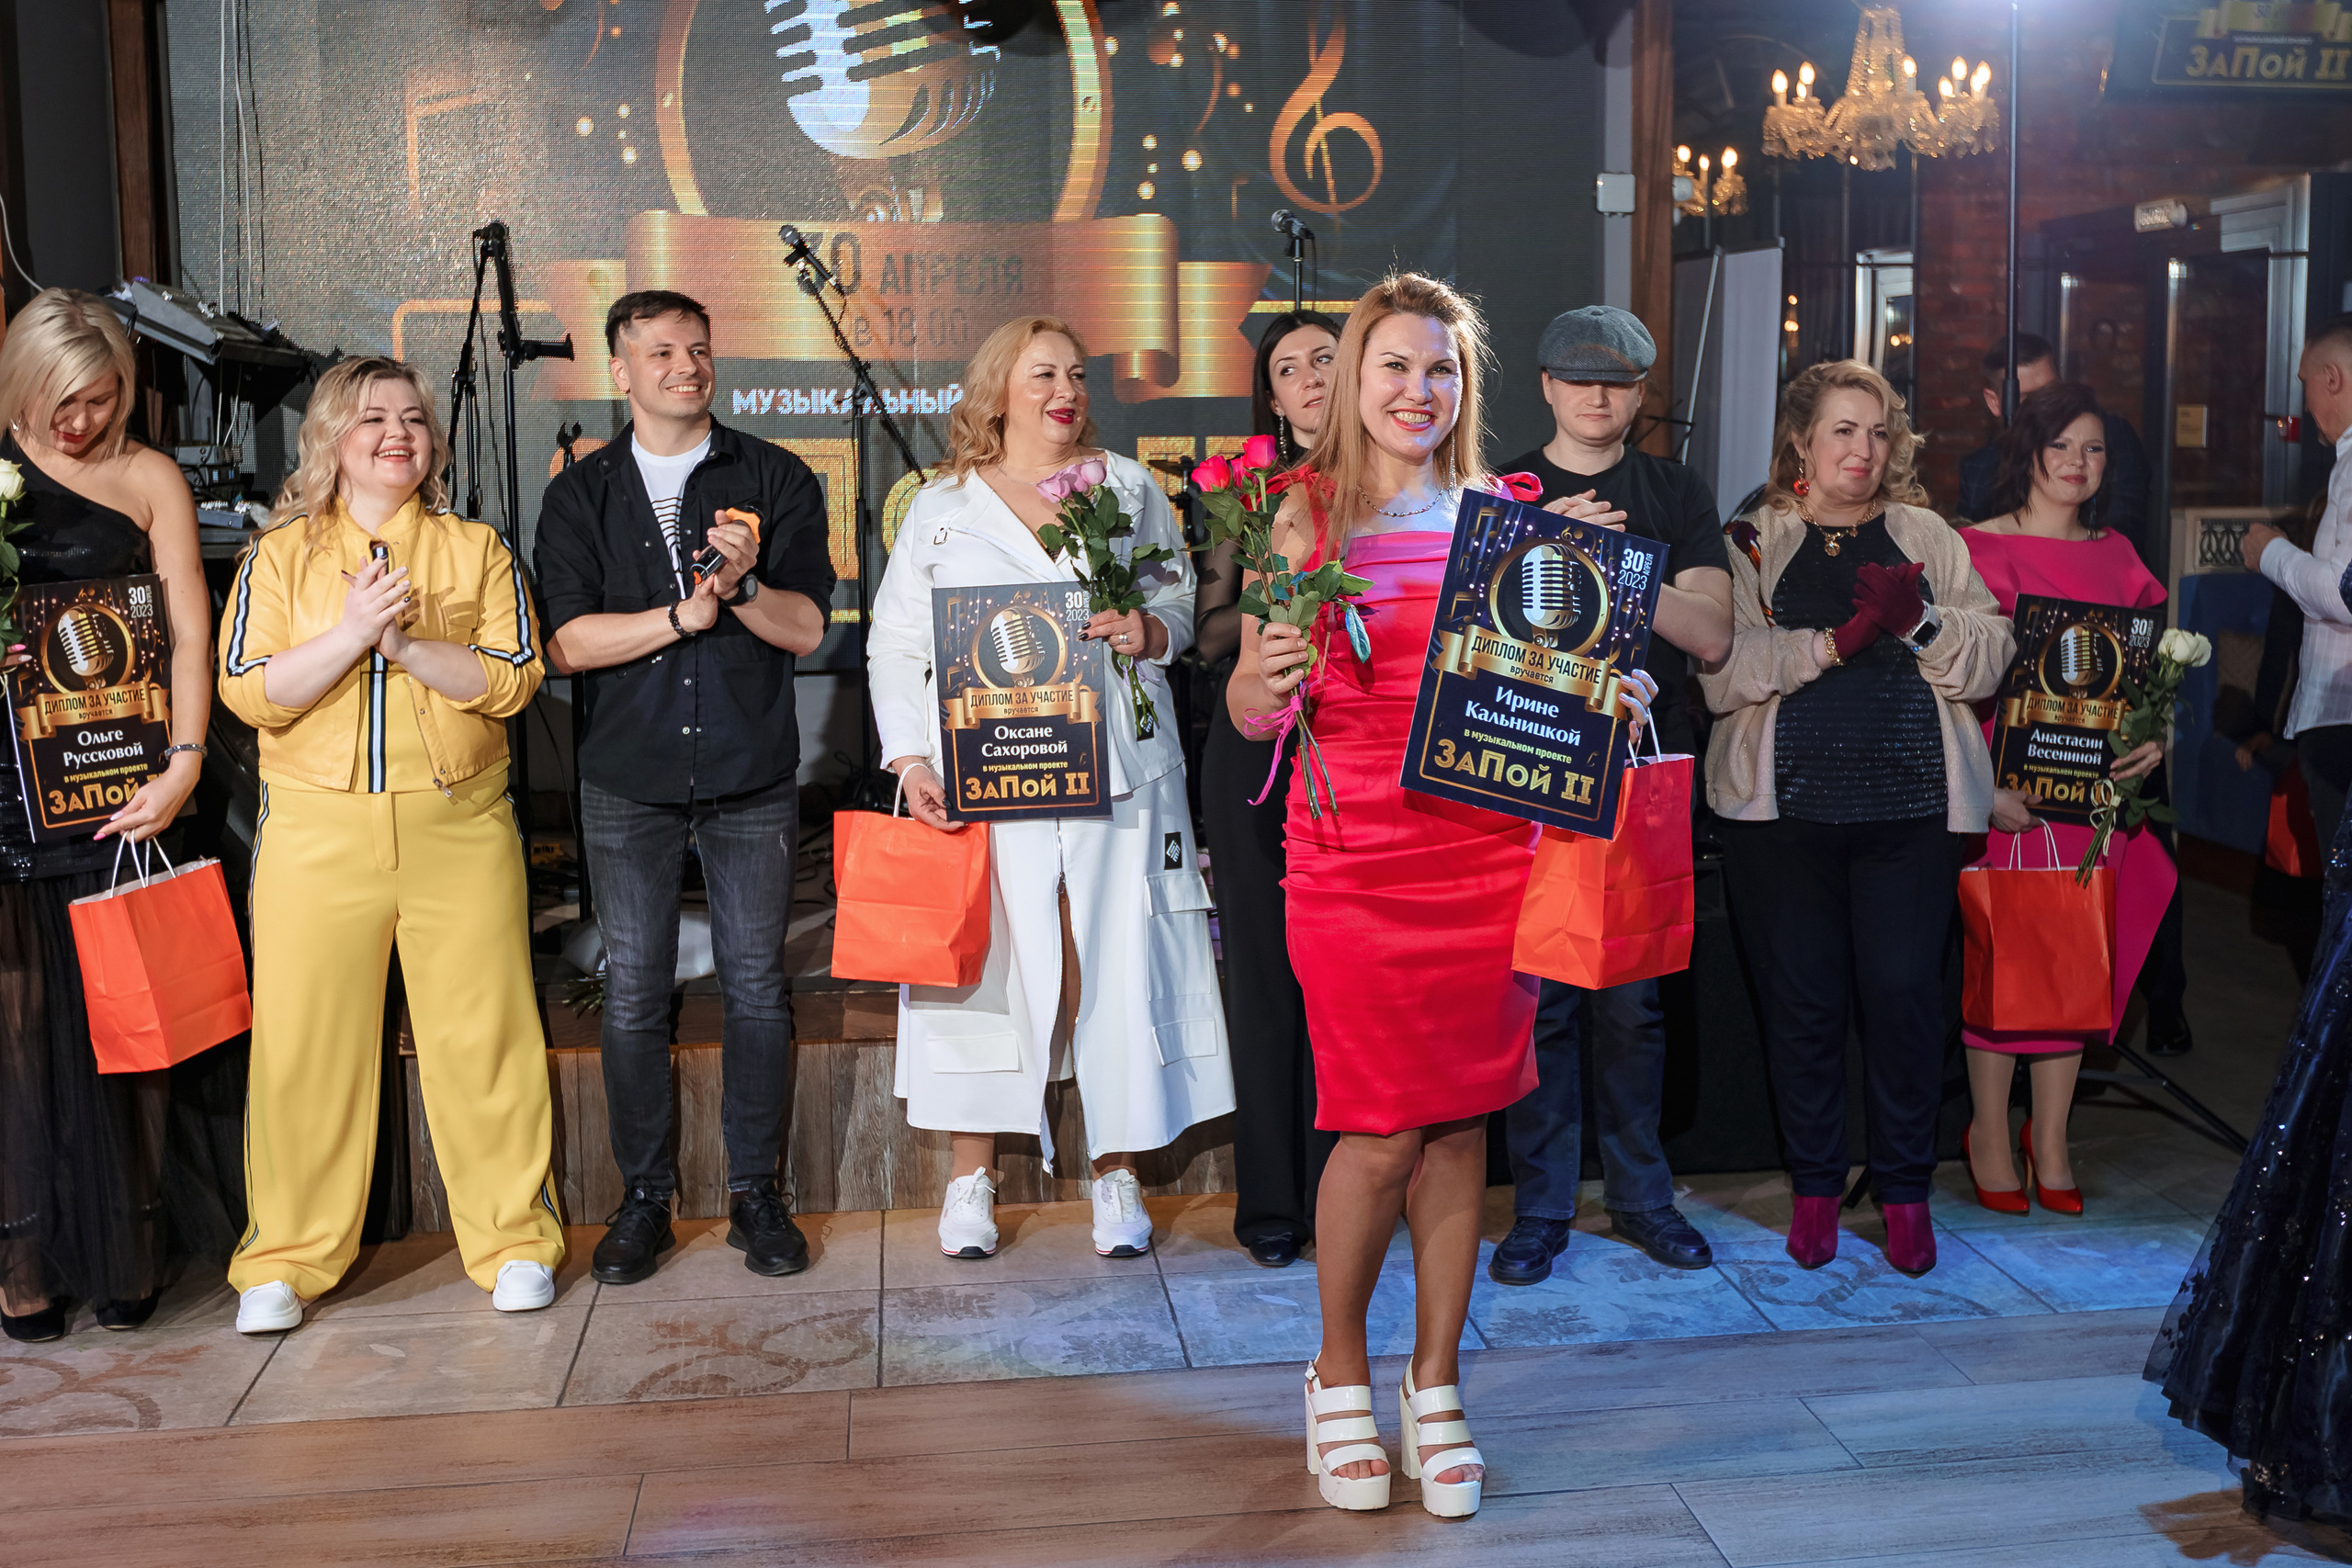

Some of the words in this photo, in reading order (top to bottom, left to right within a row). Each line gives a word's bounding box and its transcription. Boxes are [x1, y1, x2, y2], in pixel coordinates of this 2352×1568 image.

[879, 253, 1023, 295] АПРЕЛЯ
[1622, 548, 1645, 572] 30
[1643, 553, 1654, 576] АПРЕЛЯ
[1617, 569, 1648, 591] 2023
[129, 587, 146, 604] 30
[1065, 591, 1083, 609] 30
[130, 604, 153, 618] 2023
[1066, 609, 1090, 622] 2023
[2132, 617, 2147, 636] 30
[1470, 635, 1526, 664] ДИПЛОМ
[1528, 650, 1546, 669] ЗА
[1547, 656, 1602, 684] УЧАСТИЕ
[1510, 664, 1555, 684] вручается
[44, 696, 87, 716] ДИПЛОМ
[89, 694, 102, 707] ЗА
[103, 689, 145, 705] УЧАСТИЕ
[970, 692, 1013, 707] ДИПЛОМ
[1015, 693, 1028, 705] ЗА
[1030, 690, 1074, 704] УЧАСТИЕ
[1495, 686, 1559, 718] Ирине
[2027, 697, 2065, 713] ДИПЛОМ
[2067, 702, 2078, 713] ЗА
[2081, 704, 2119, 719] УЧАСТИЕ
[1003, 706, 1039, 715] вручается
[994, 726, 1053, 739] Оксане
[1465, 701, 1580, 747] Кальницкой
[77, 729, 123, 746] Ольге
[1464, 729, 1470, 738] в
[1471, 730, 1534, 755] музыкальном
[1535, 747, 1572, 764] проекте
[2030, 728, 2103, 750] Анастасии
[63, 741, 143, 769] Руссковой
[981, 740, 1068, 759] Сахоровой
[2028, 743, 2102, 765] Весениной
[988, 762, 1037, 773] музыкальном
[1039, 761, 1069, 771] проекте
[1065, 773, 1091, 795] II
[1561, 771, 1595, 805] II
